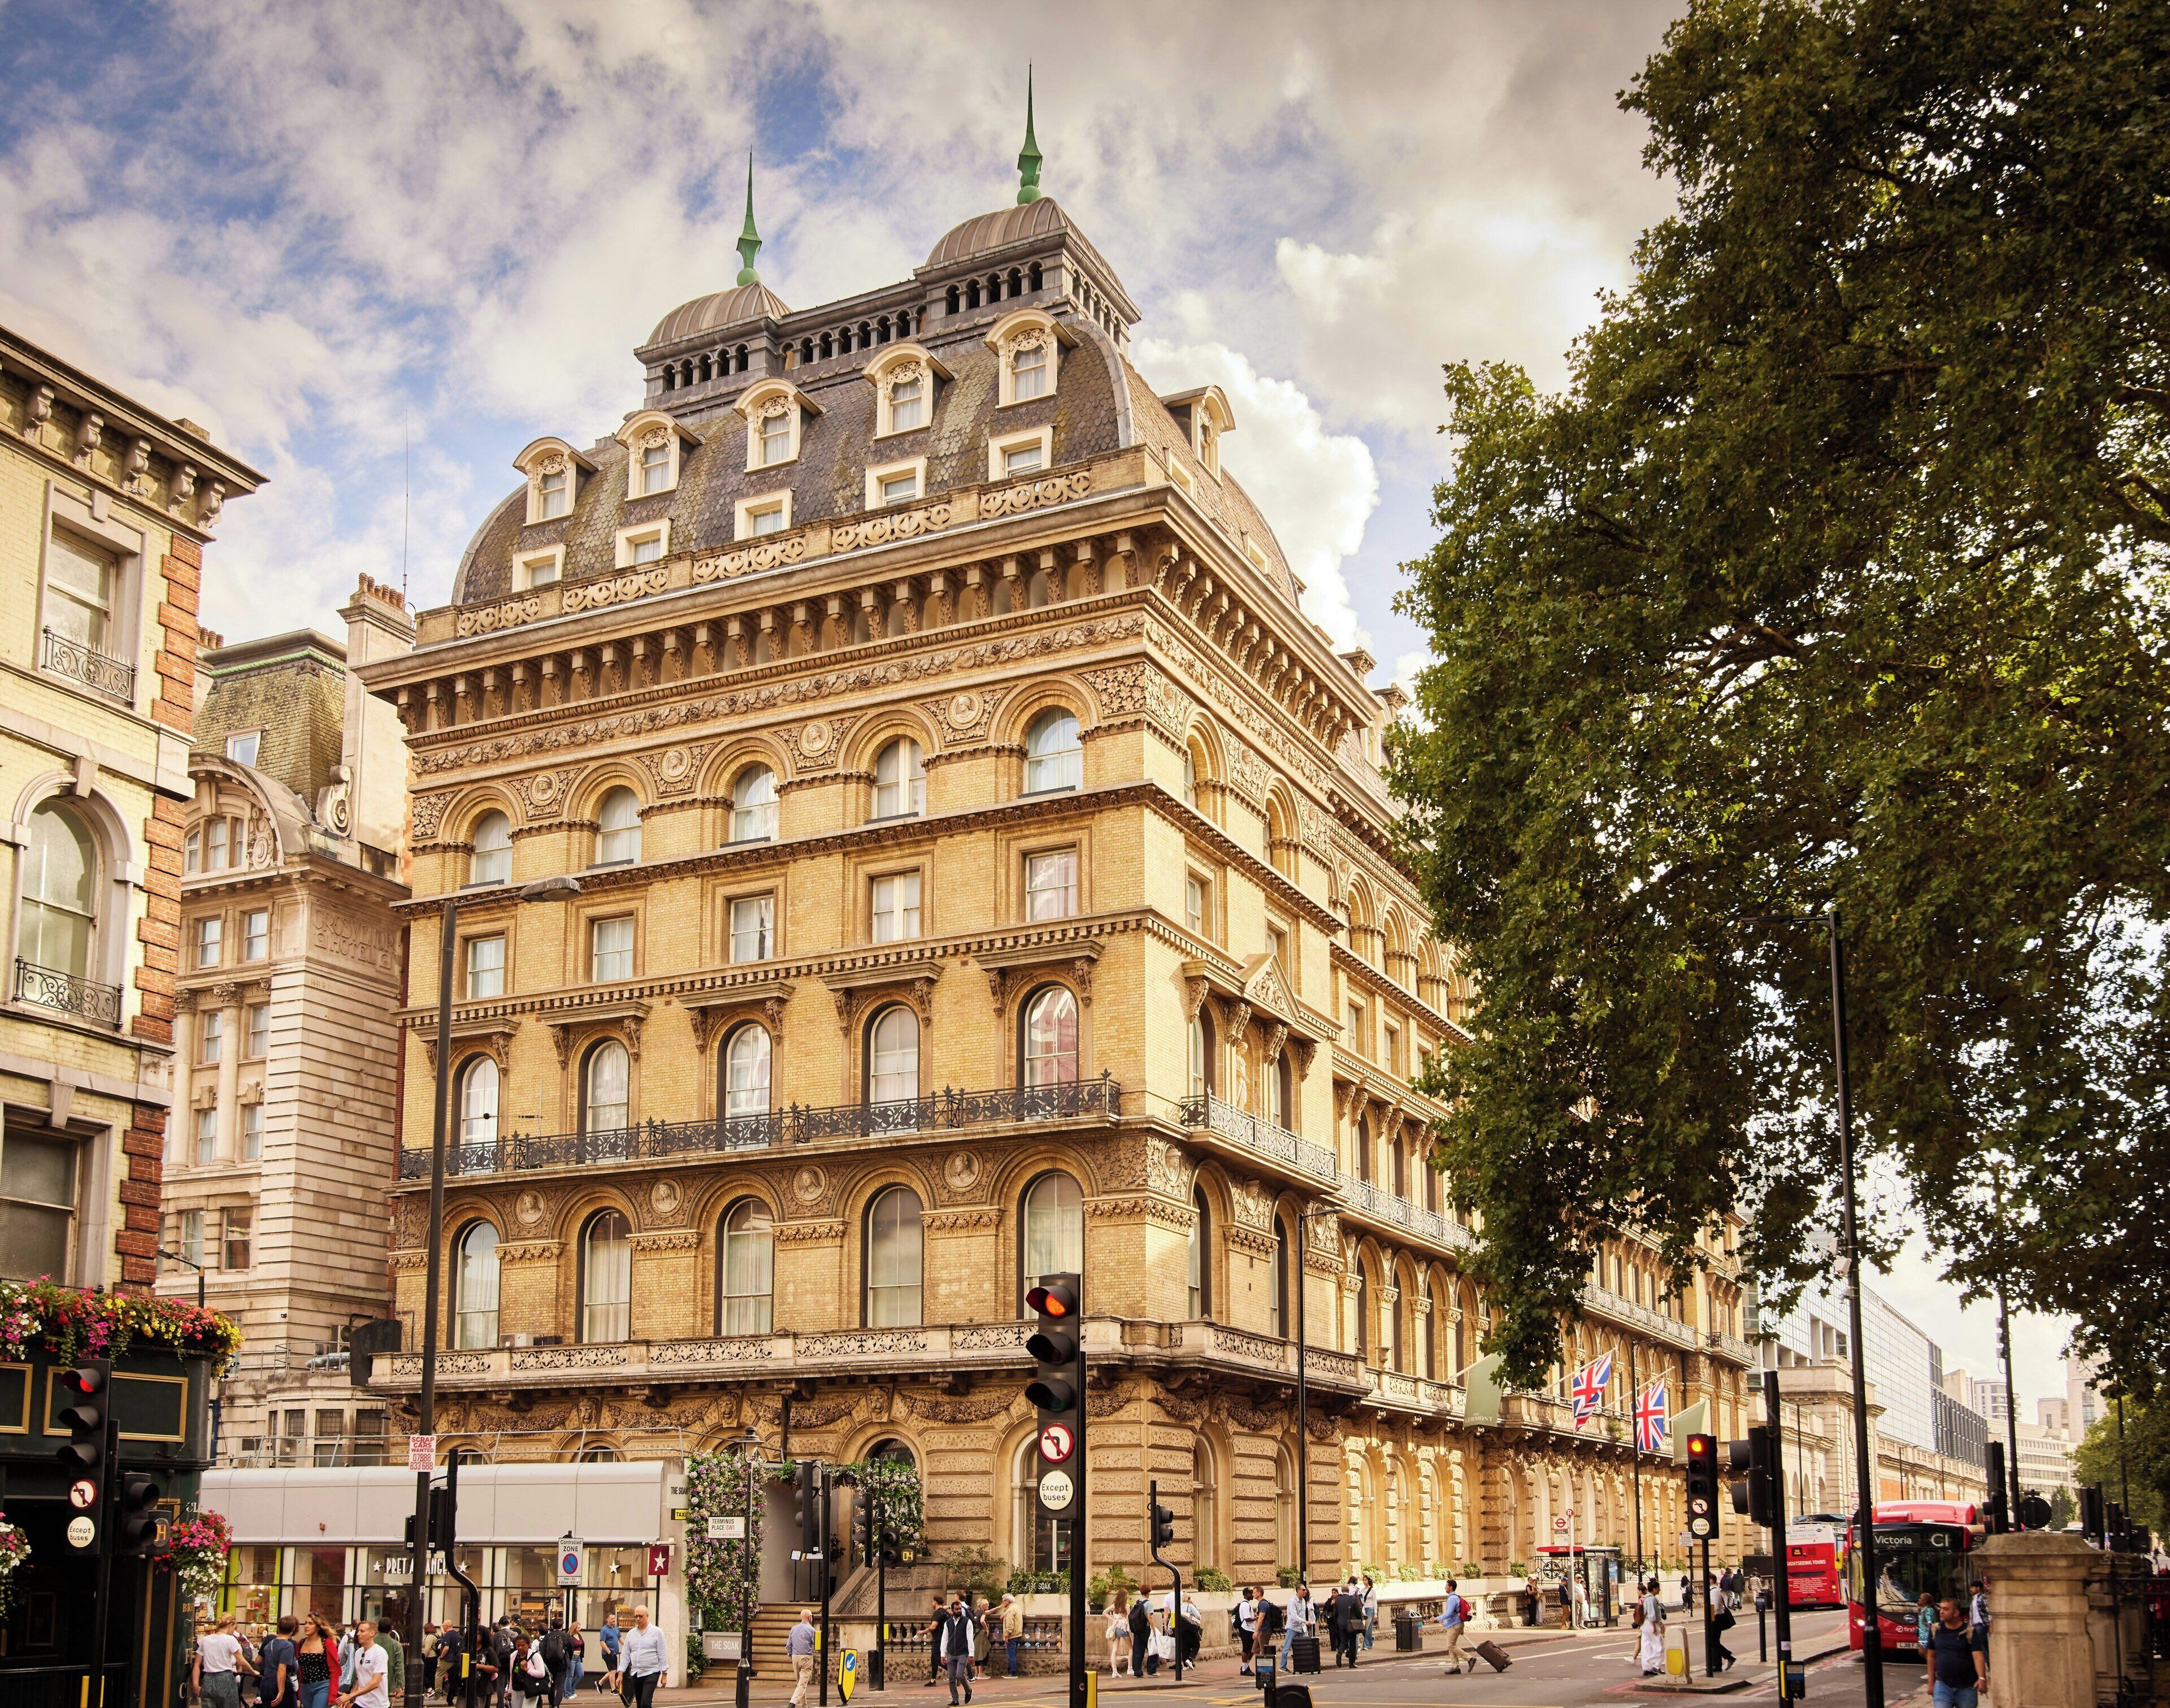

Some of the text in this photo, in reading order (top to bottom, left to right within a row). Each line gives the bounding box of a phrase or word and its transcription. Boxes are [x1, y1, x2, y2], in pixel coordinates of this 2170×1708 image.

[314, 909, 394, 952] GROSVENOR
[327, 935, 376, 965] HOTEL
[410, 1462, 433, 1470] 833 688
[1041, 1484, 1069, 1492] Except
[1874, 1535, 1912, 1544] Victoria
[903, 1551, 913, 1560] 04
[386, 1558, 407, 1574] PRET
[425, 1558, 450, 1575] ANGE
[711, 1641, 739, 1650] THE SOAK
